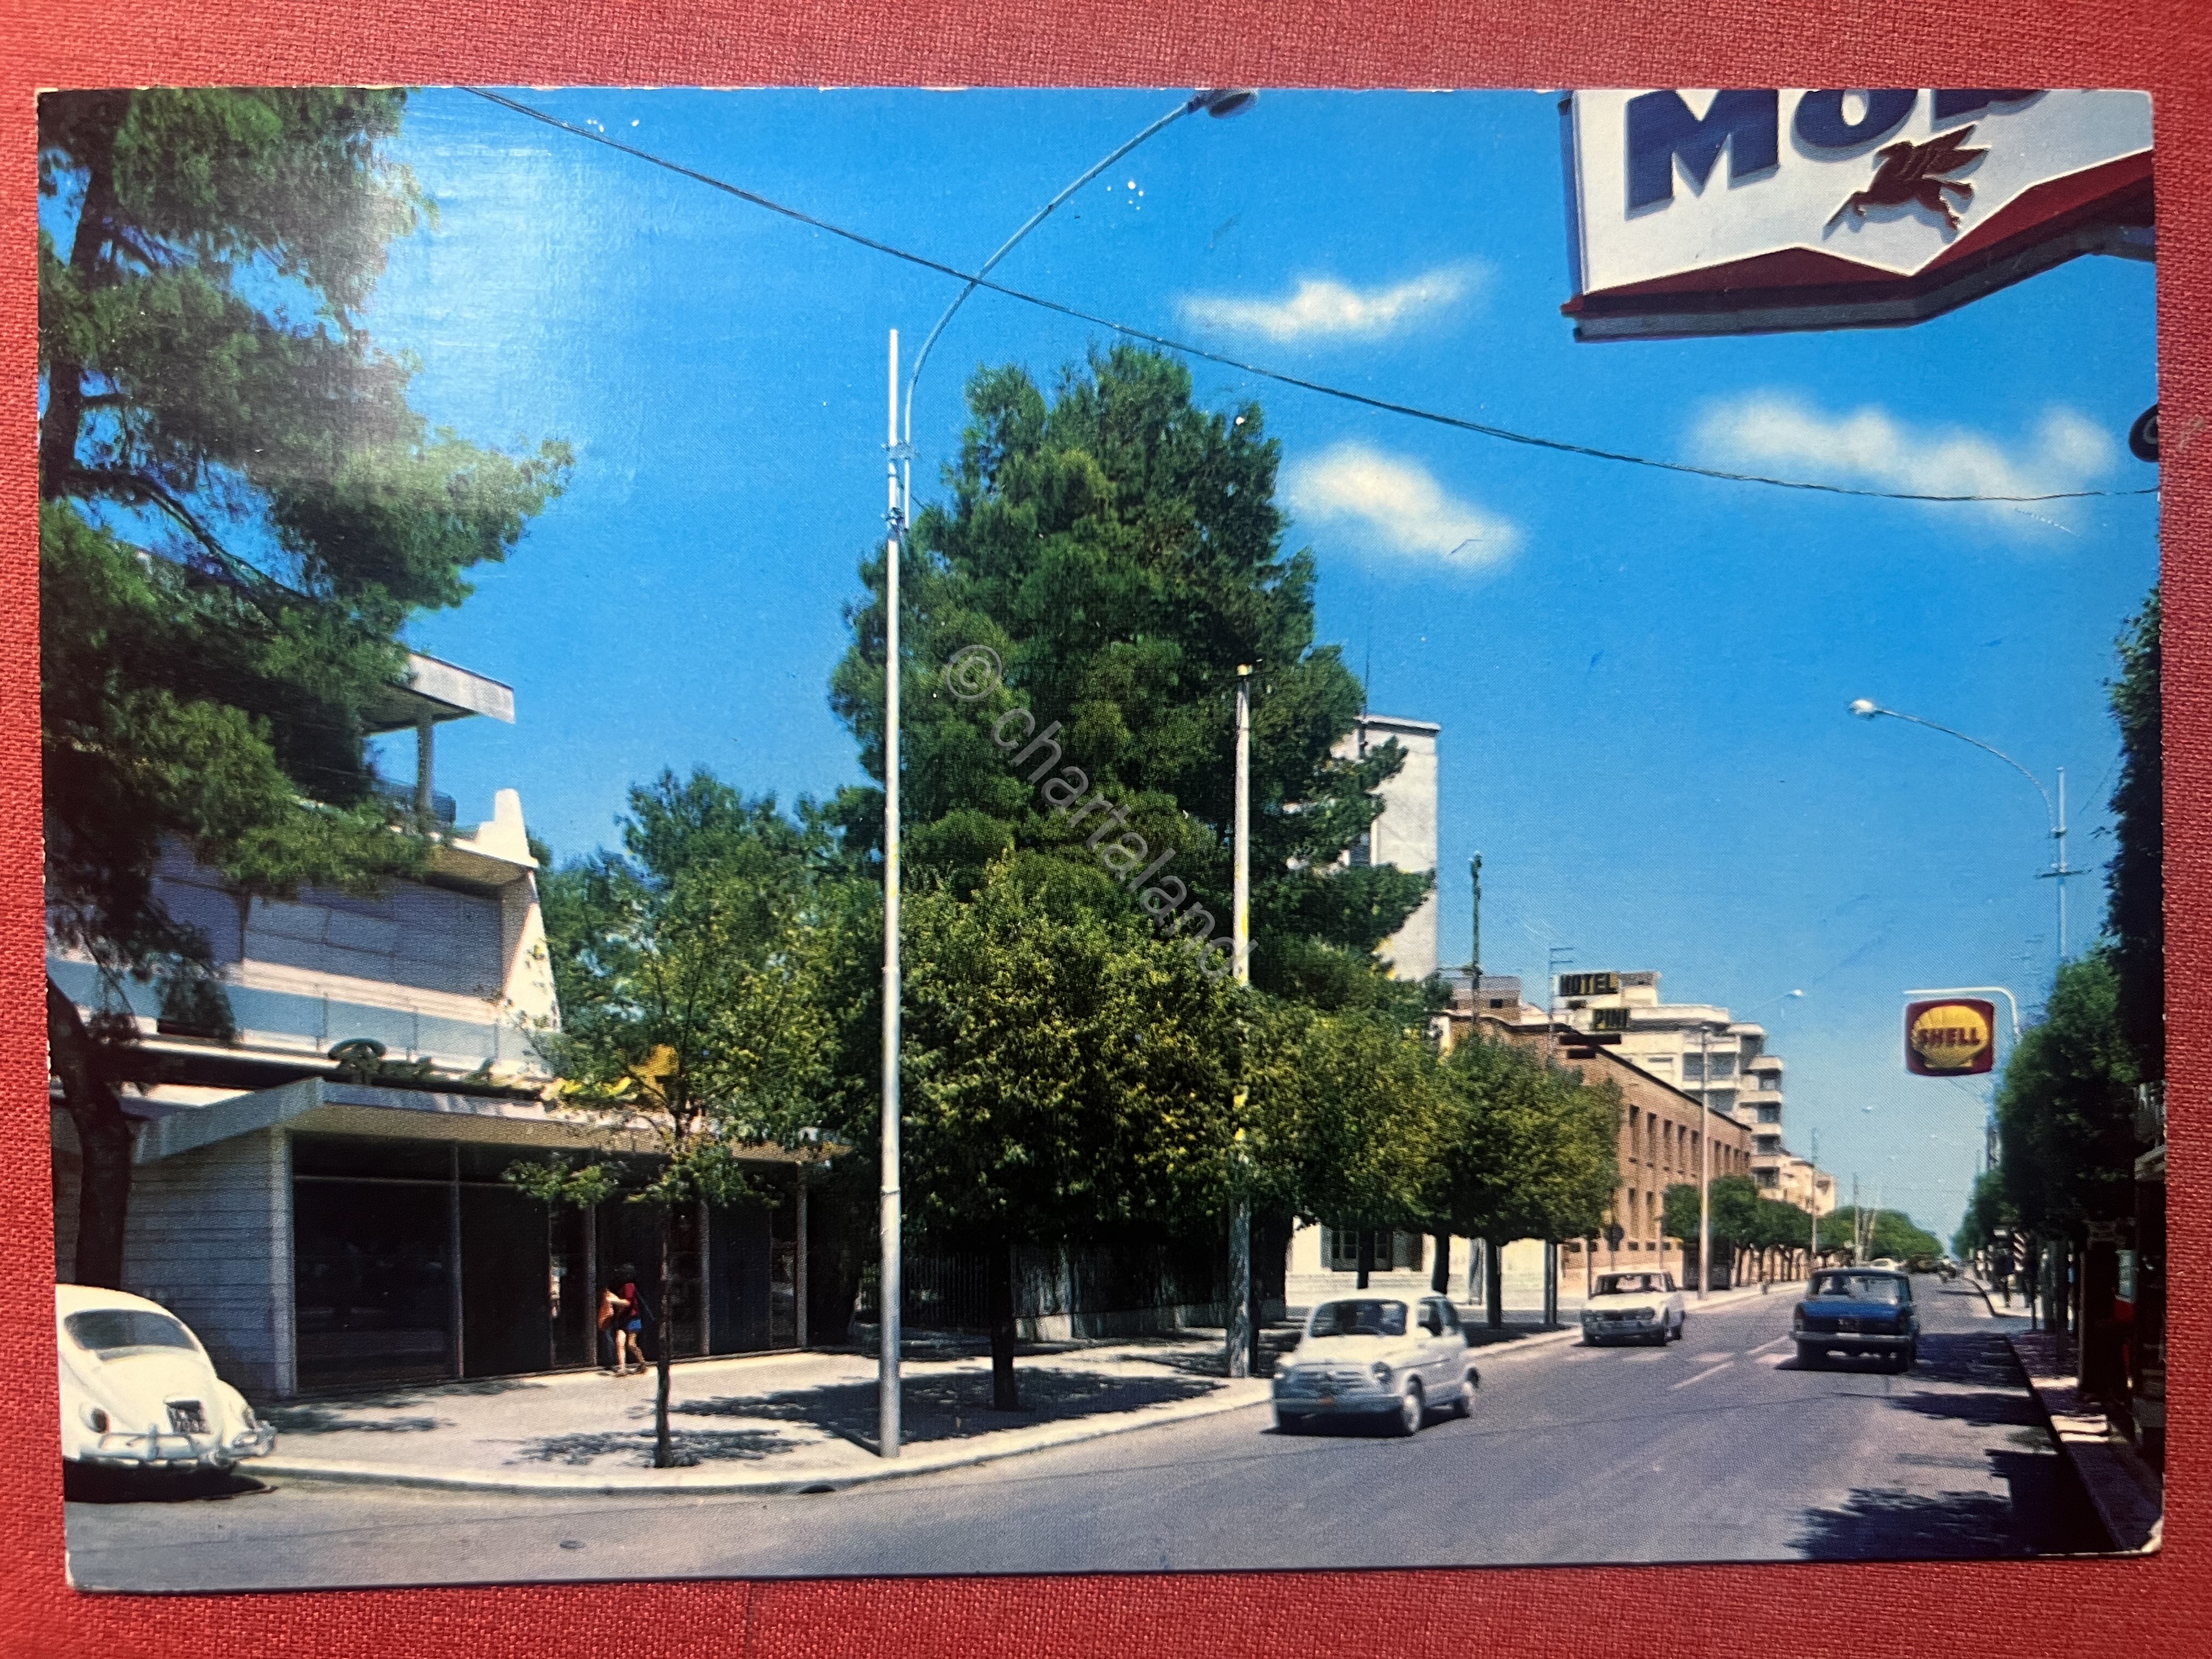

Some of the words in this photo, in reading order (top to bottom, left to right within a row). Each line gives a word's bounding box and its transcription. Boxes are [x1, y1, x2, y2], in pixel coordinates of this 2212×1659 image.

[1625, 89, 2043, 218] MO
[1560, 973, 1617, 996] HOTEL
[1919, 1027, 1980, 1046] SHELL
